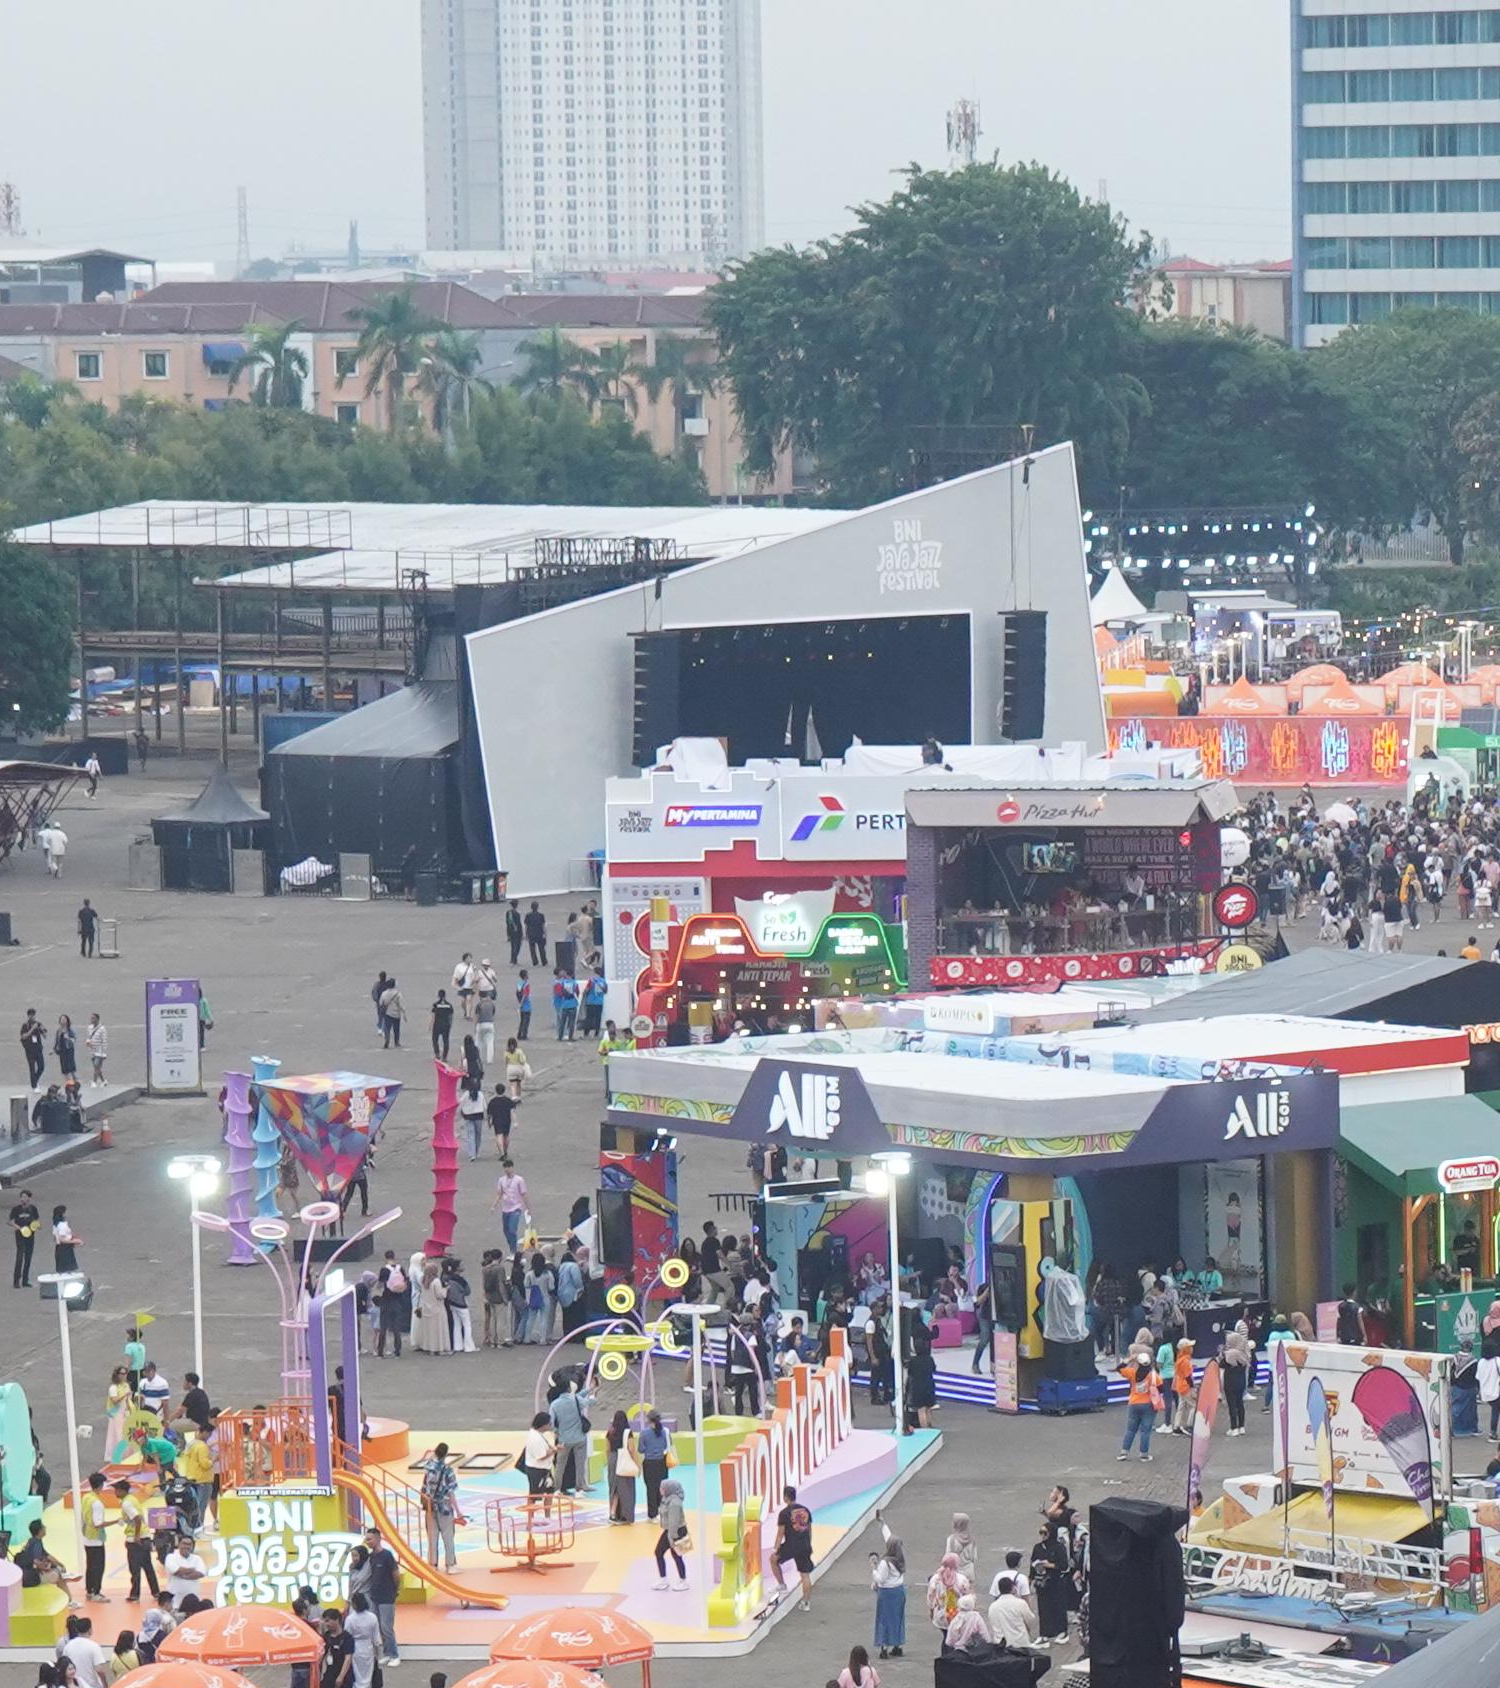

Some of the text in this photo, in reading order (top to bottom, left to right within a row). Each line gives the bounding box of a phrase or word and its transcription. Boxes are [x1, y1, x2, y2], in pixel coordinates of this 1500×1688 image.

[893, 519, 922, 543] BNI
[762, 926, 807, 942] Fresh
[249, 1501, 314, 1534] BNI
